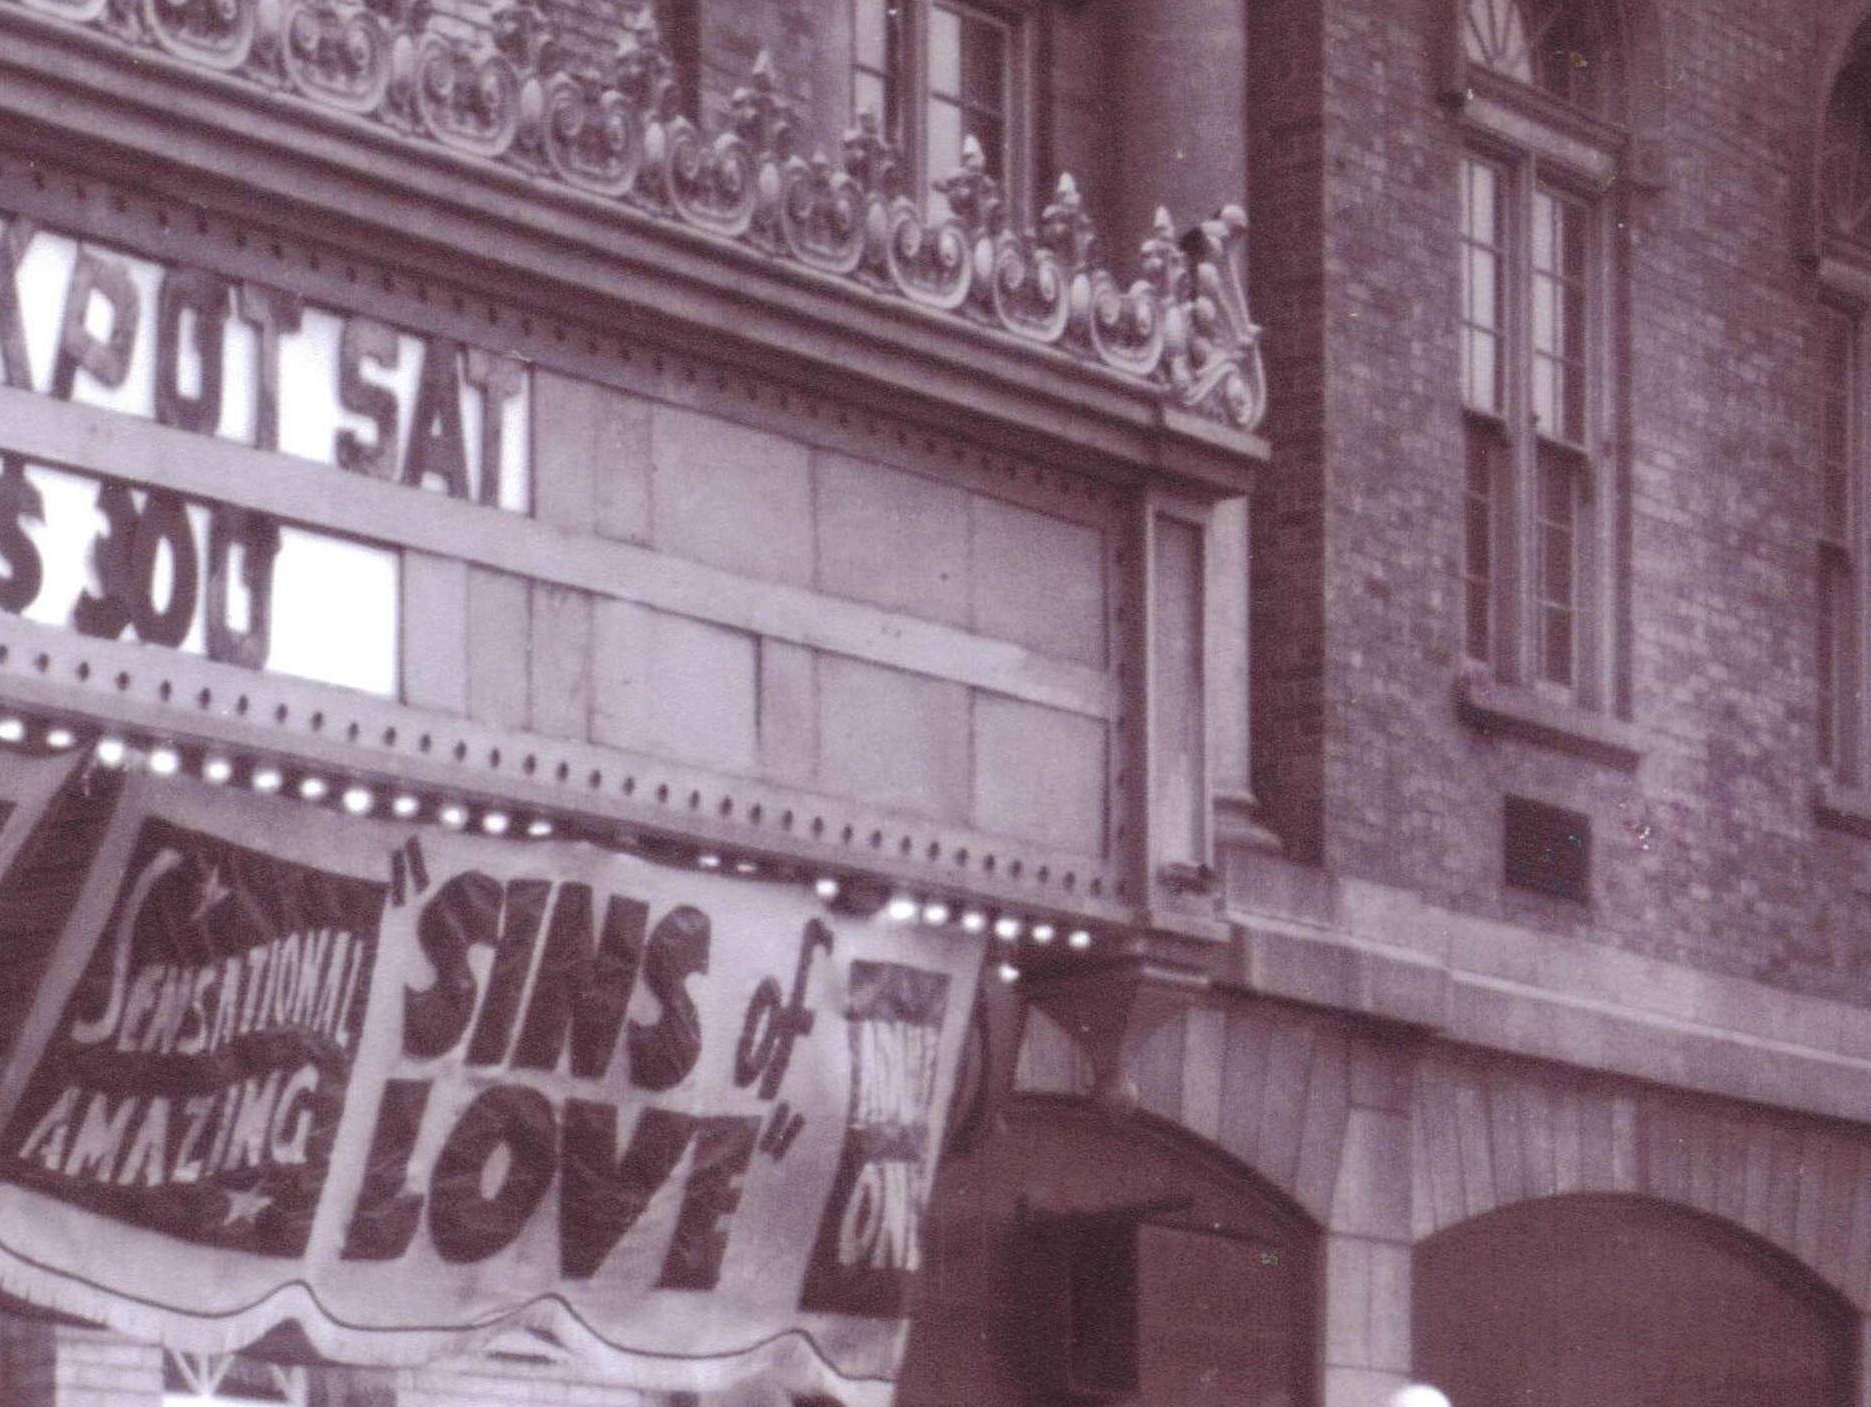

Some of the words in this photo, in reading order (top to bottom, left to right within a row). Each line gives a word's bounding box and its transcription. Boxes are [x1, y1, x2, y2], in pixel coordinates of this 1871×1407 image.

[334, 322, 524, 511] SAT
[70, 847, 365, 1057] SENSATIONAL
[733, 917, 835, 1102] of
[18, 1063, 320, 1188] AMAZING
